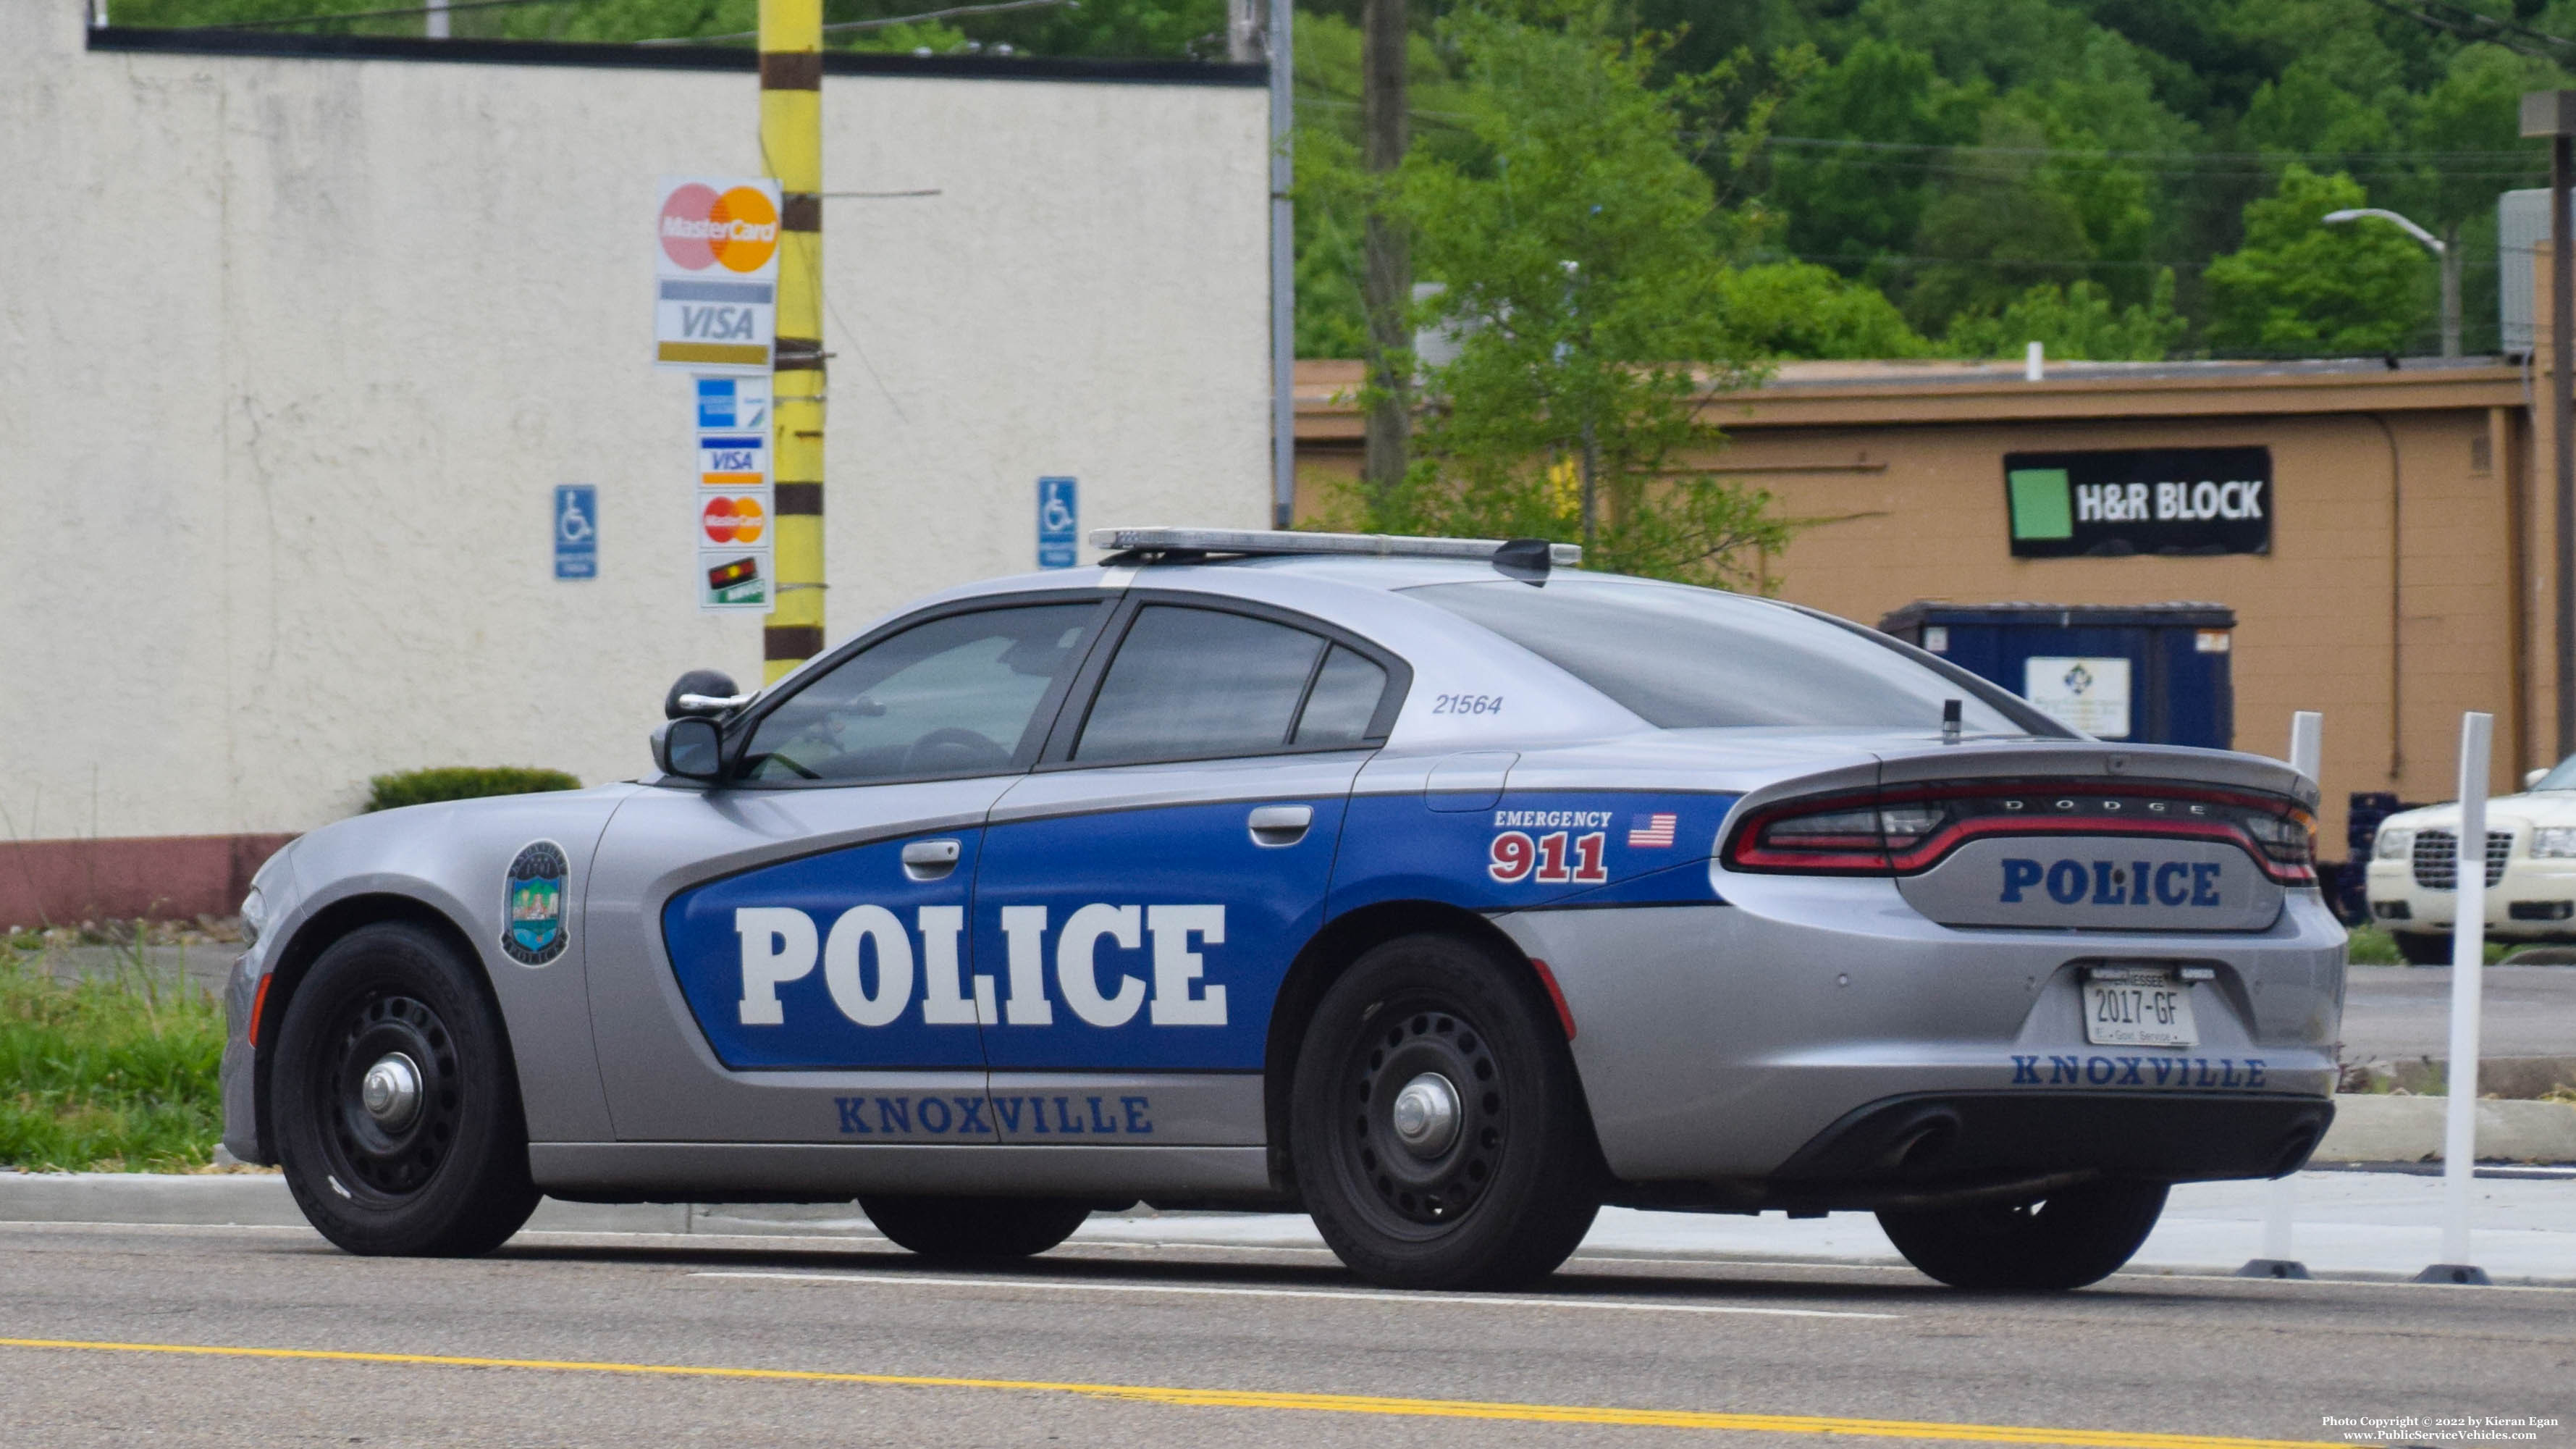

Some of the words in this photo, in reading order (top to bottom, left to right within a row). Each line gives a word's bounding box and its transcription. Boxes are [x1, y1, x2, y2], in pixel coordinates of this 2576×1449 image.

[662, 216, 777, 243] MasterCard
[681, 306, 754, 340] VISA
[712, 451, 753, 469] VISA
[2076, 482, 2150, 521] H&R
[2155, 481, 2263, 521] BLOCK
[1433, 694, 1504, 715] 21564
[1494, 810, 1612, 828] EMERGENCY
[2004, 799, 2205, 815] DODGE
[1488, 831, 1608, 883] 911
[1999, 858, 2221, 907] POLICE
[734, 903, 1229, 1028] POLICE
[2095, 988, 2179, 1025] 2017-GF
[2011, 1055, 2268, 1087] KNOXVILLE
[834, 1095, 1154, 1135] KNOXVILLE
